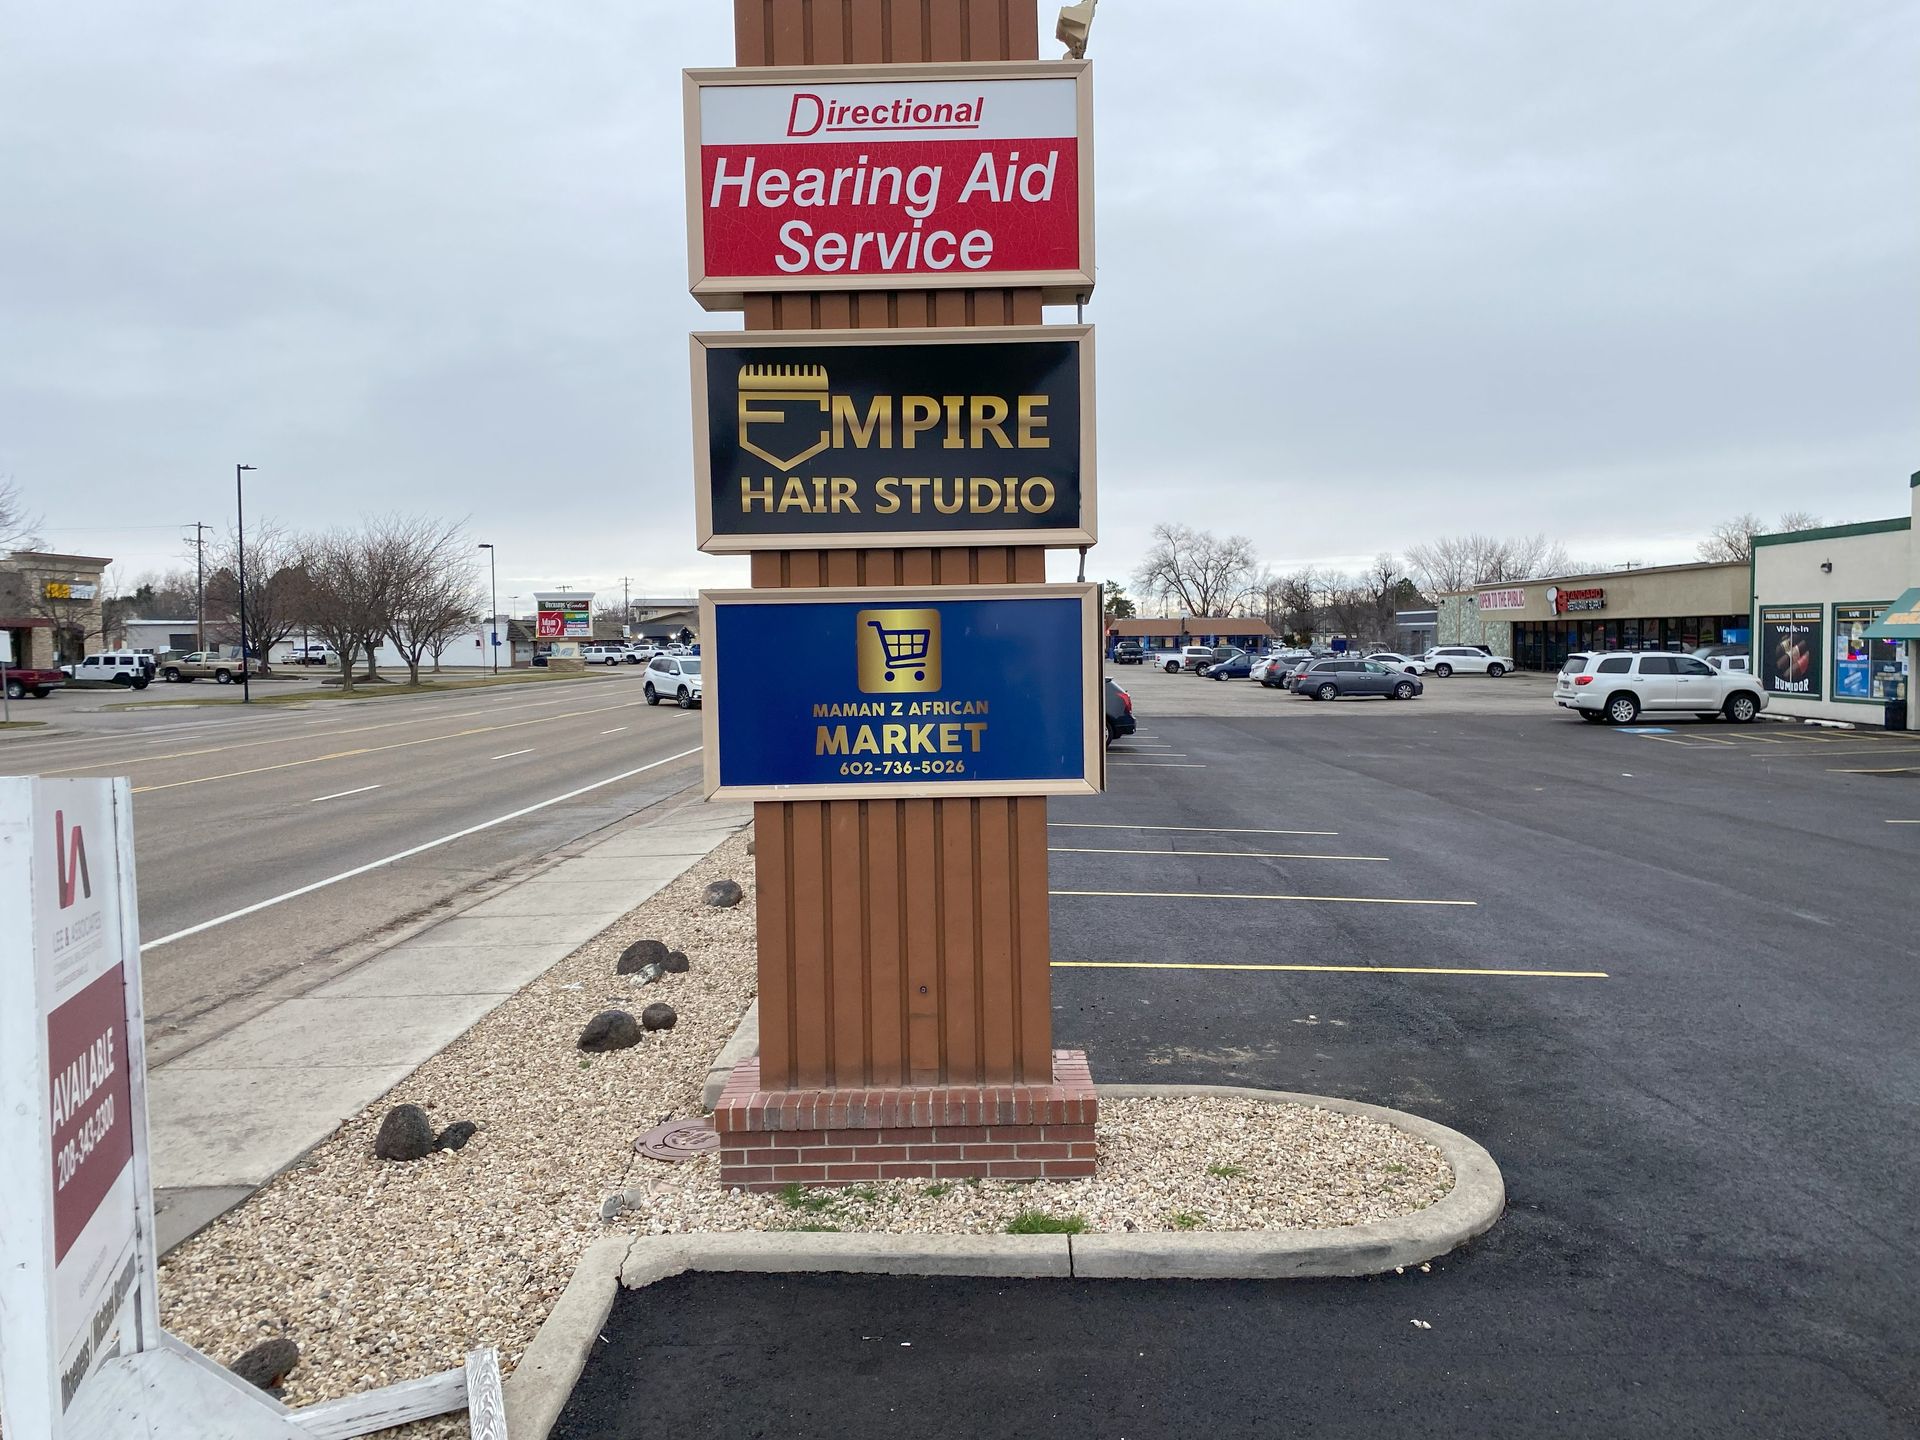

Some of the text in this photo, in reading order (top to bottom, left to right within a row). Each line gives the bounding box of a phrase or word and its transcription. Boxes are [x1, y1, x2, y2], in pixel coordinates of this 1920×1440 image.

[786, 93, 985, 138] Directional
[709, 150, 1059, 219] Hearing Aid
[774, 218, 994, 273] Service
[738, 389, 1050, 471] EMPIRE
[740, 476, 1056, 514] HAIR STUDIO
[1480, 589, 1525, 608] OPEN TO THE PUBLIC
[1776, 625, 1809, 633] Walk-In
[1774, 675, 1809, 692] HUMIDOR
[813, 701, 989, 717] MAMAN Z AFRICAN
[815, 722, 988, 755] MARKET
[839, 760, 965, 775] 602-736-5026
[52, 1026, 114, 1136] AVAILABLE
[57, 1093, 115, 1192] 208-343-2300
